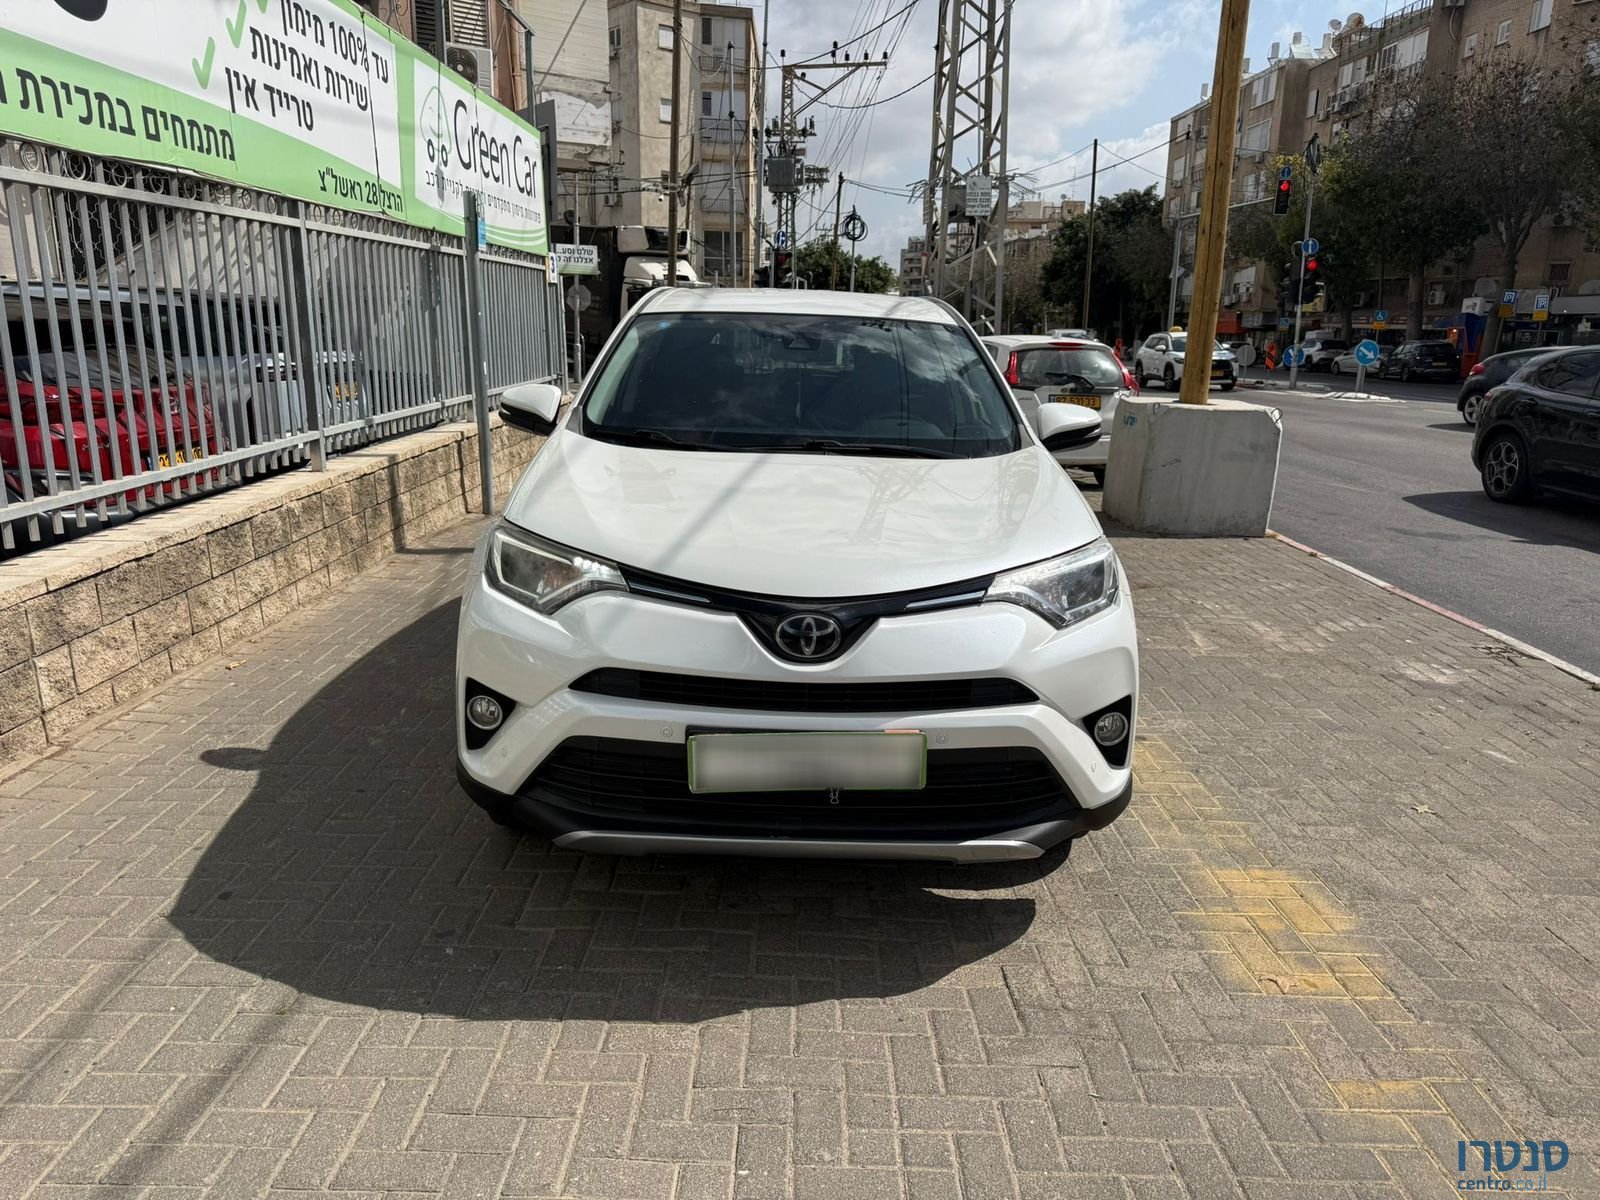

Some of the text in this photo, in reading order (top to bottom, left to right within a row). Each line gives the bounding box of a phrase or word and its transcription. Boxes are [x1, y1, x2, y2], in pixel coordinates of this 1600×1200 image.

[249, 26, 368, 112] שירות ואמינות
[281, 0, 389, 84] עד 100% מימון
[16, 68, 136, 136] במכירת
[225, 66, 314, 131] טרייד אין
[141, 105, 236, 161] מתמחים
[454, 99, 537, 199] Green Car
[365, 181, 378, 206] 28
[380, 184, 403, 213] הרצל
[573, 255, 594, 264] אצלנו
[577, 247, 594, 256] שלם
